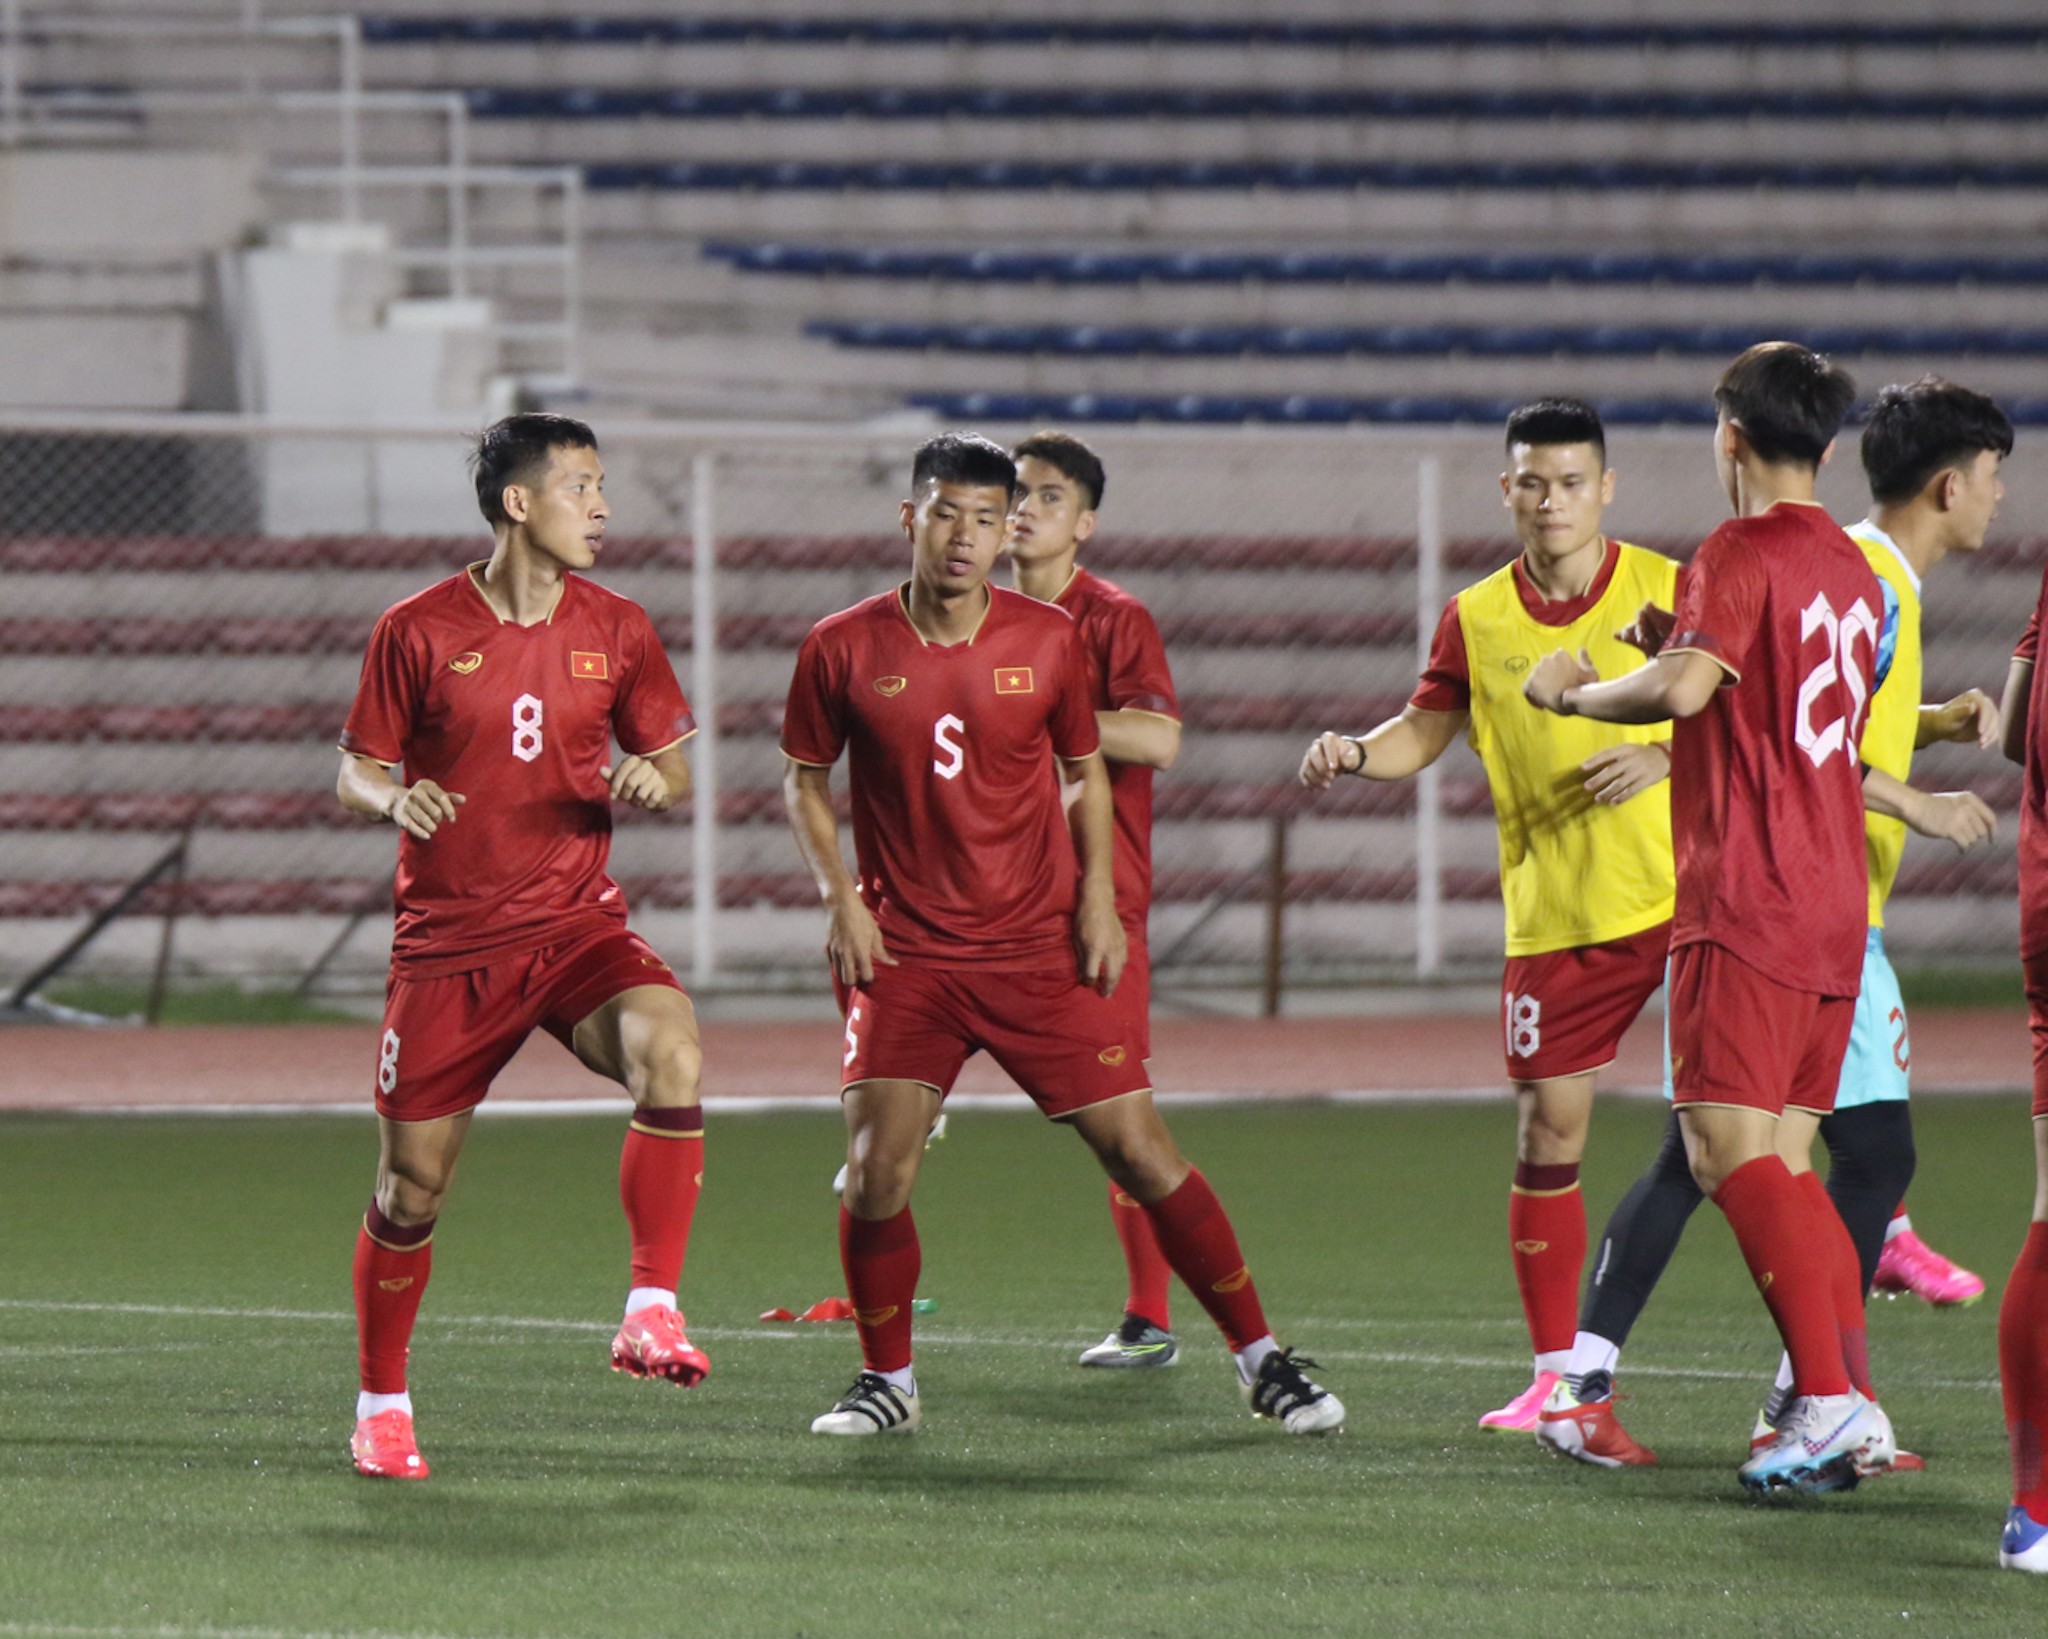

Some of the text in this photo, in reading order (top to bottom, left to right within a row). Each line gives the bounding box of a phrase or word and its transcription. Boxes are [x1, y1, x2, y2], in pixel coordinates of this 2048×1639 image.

[512, 692, 543, 763] 8
[1505, 991, 1540, 1058] 18
[379, 1027, 401, 1095] 8
